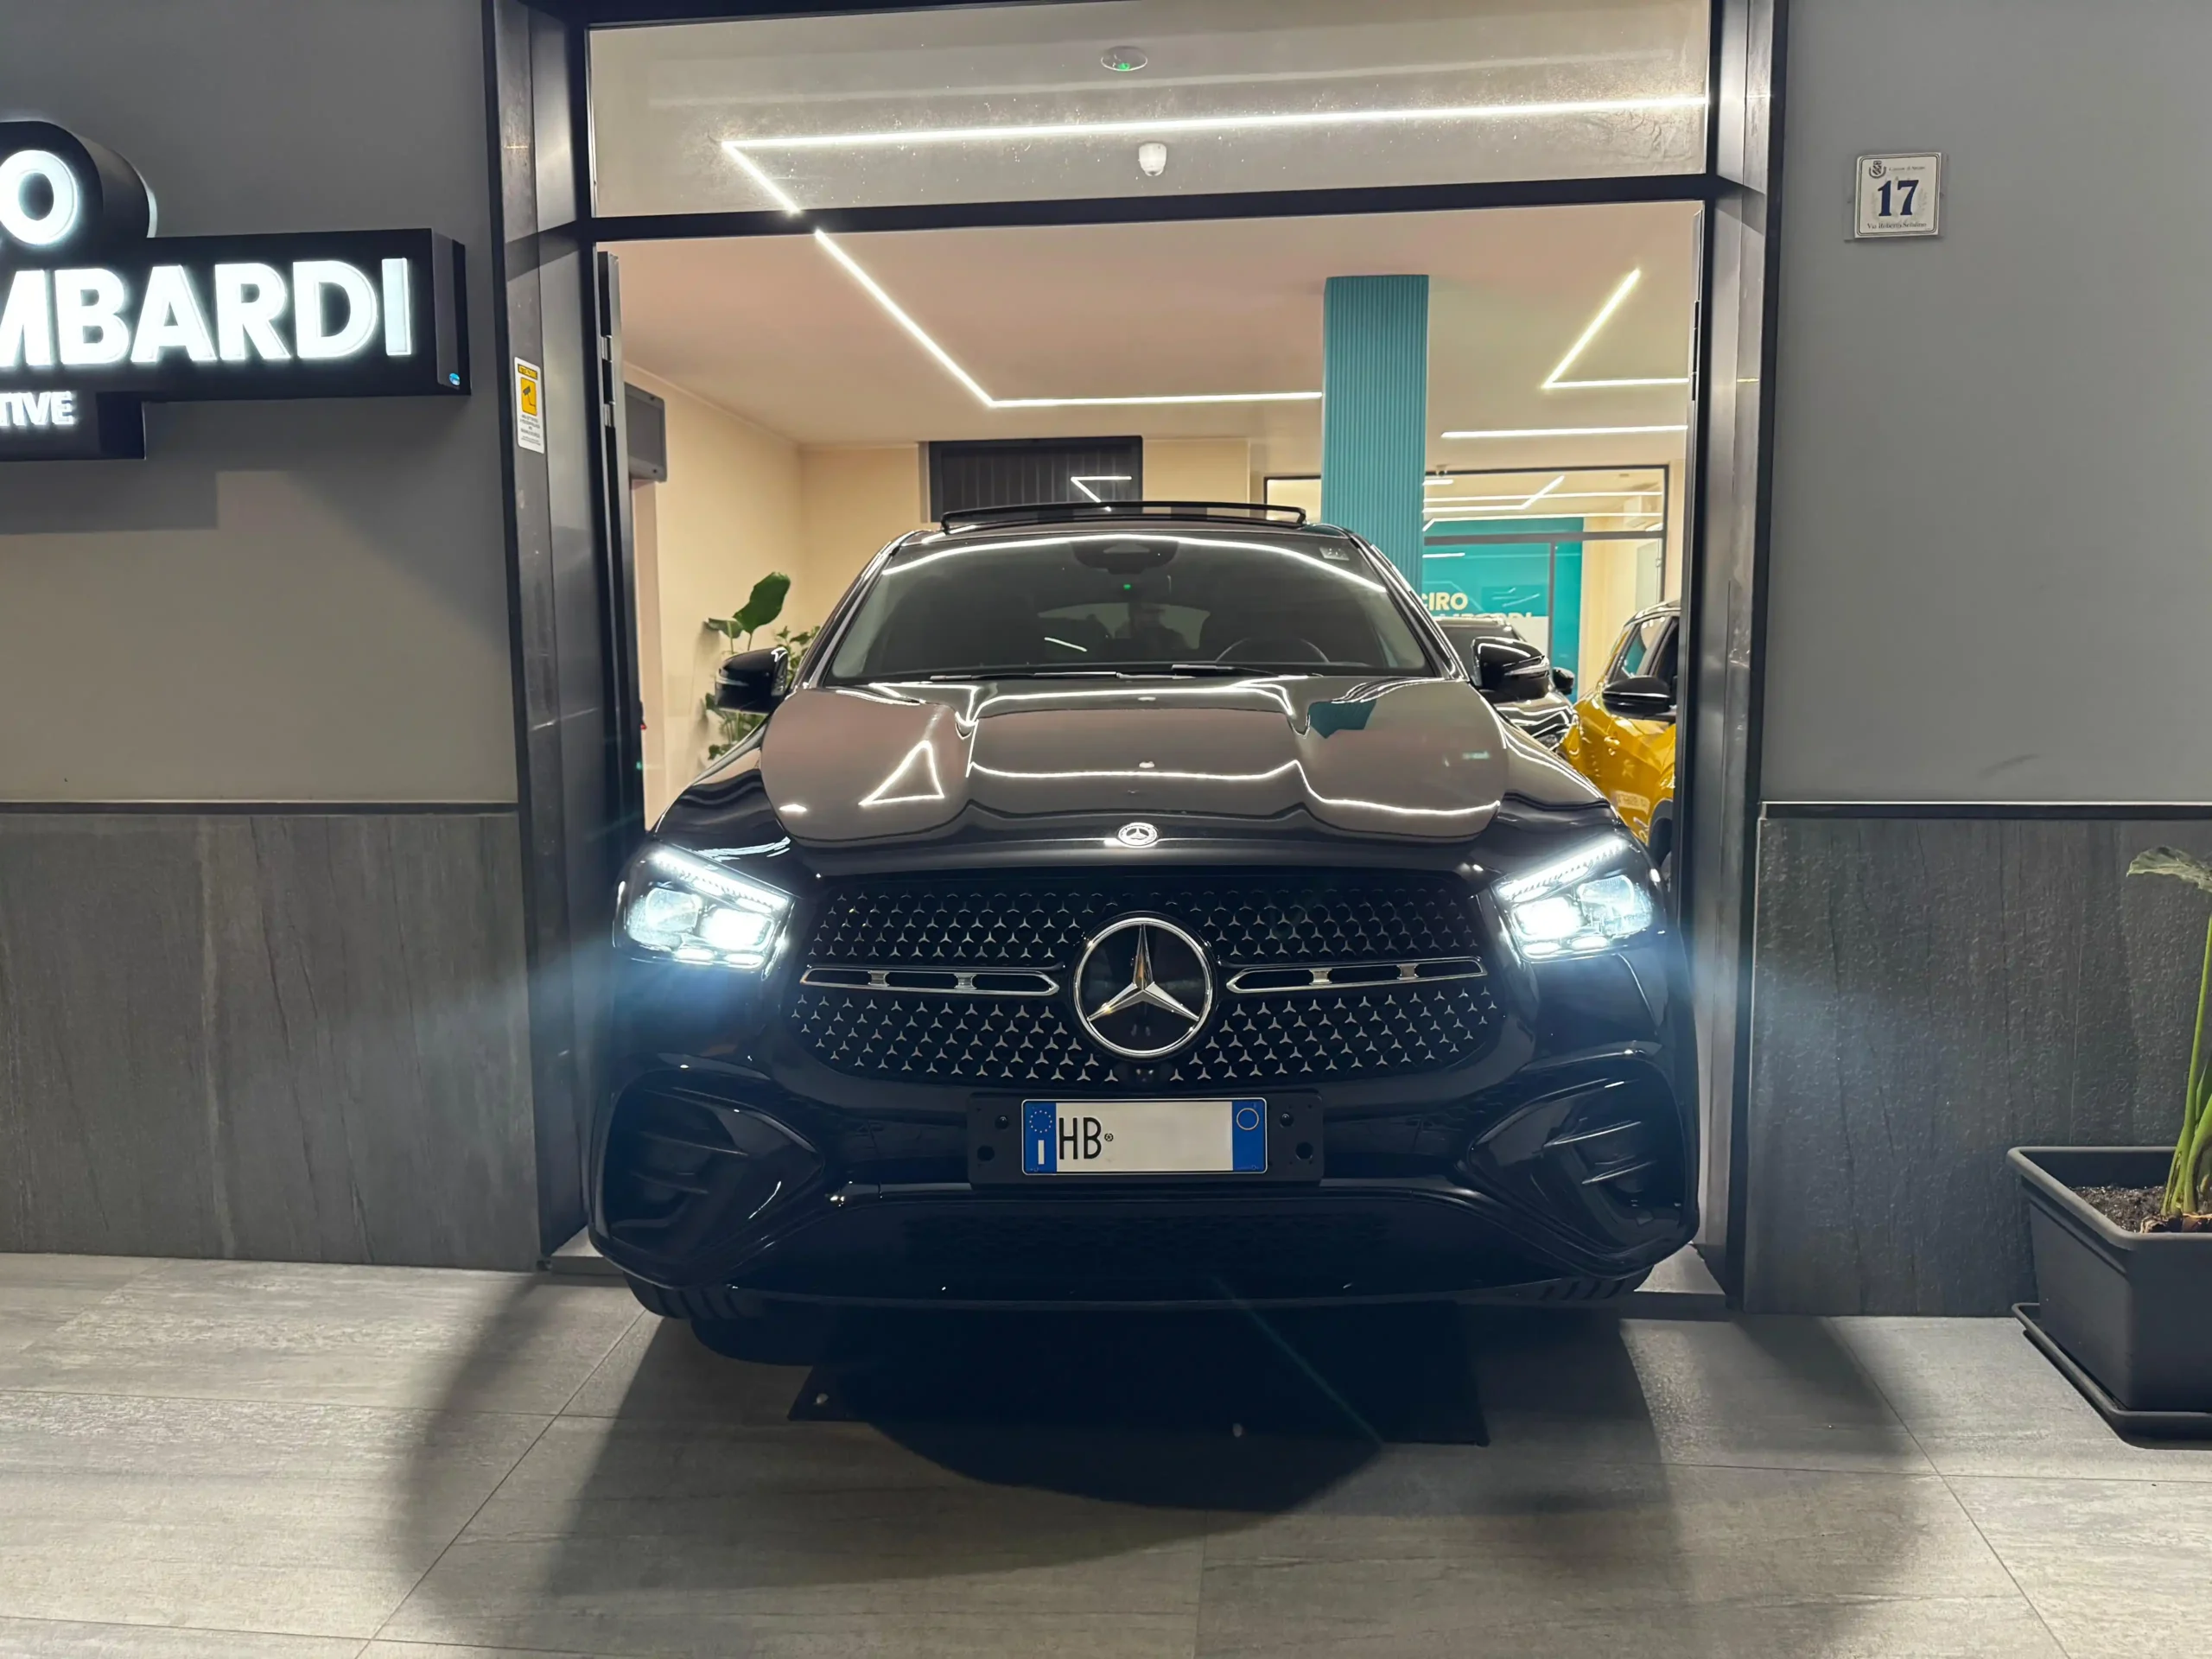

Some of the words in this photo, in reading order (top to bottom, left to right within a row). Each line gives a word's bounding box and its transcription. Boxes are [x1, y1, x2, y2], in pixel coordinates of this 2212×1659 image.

[0, 149, 79, 245] O
[1878, 180, 1919, 216] 17
[1058, 1117, 1102, 1160] HB
